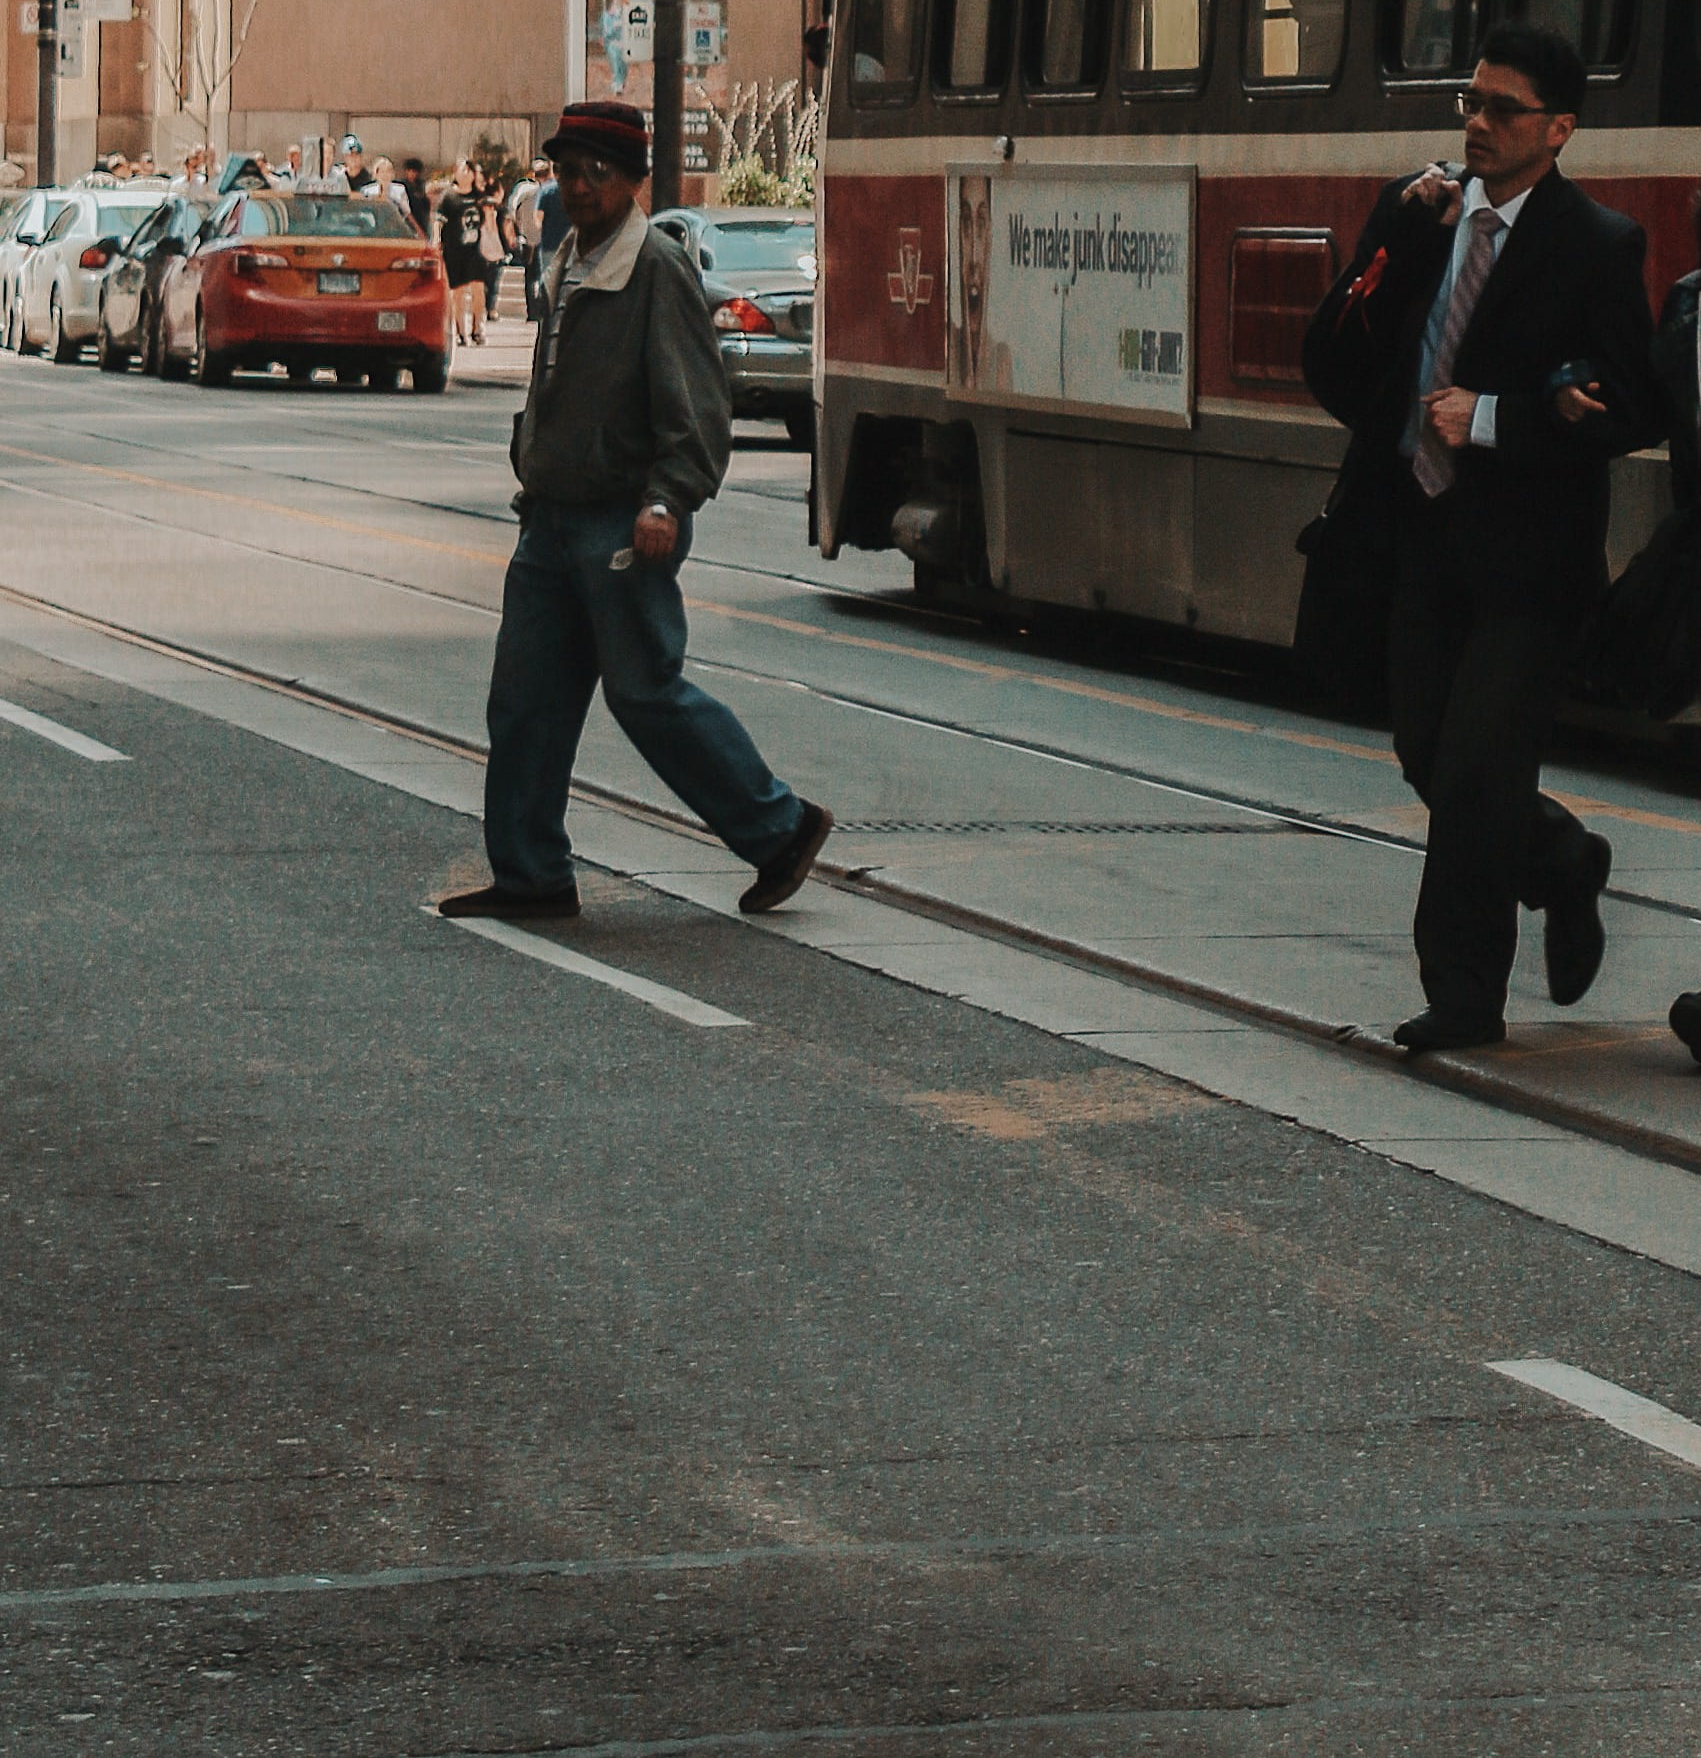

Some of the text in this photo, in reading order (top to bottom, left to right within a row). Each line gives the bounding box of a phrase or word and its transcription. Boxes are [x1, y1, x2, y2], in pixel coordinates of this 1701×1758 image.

[1008, 212, 1031, 269] We
[1033, 212, 1070, 271] make
[1071, 212, 1106, 286] junk
